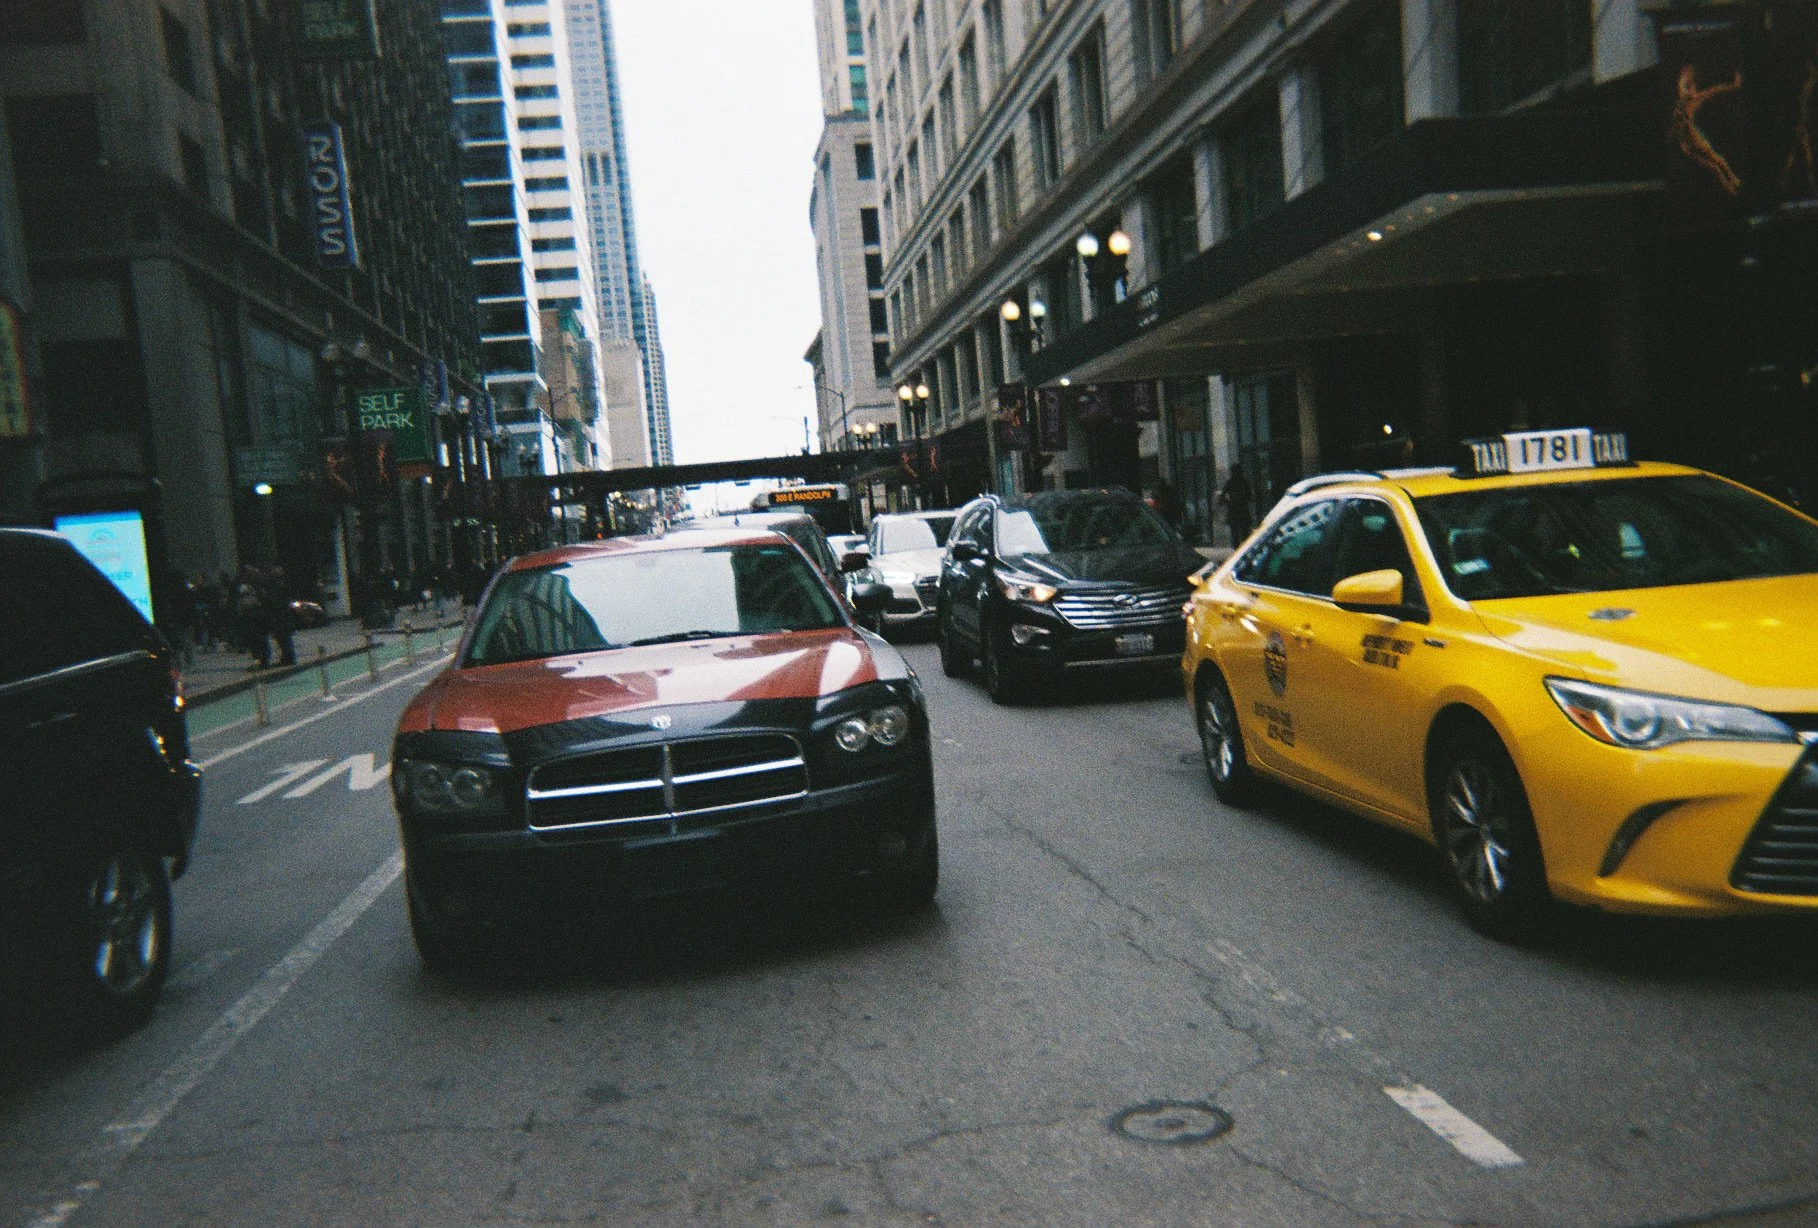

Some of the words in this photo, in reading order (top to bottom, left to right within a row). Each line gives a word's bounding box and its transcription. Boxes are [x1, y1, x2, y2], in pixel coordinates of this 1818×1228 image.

[305, 19, 359, 40] PARK
[309, 134, 346, 256] ROSS
[359, 393, 405, 413] SELF
[360, 411, 415, 431] PARK
[1472, 442, 1507, 473] TAXI
[1520, 434, 1580, 465] 1781
[1593, 433, 1625, 463] TAXI
